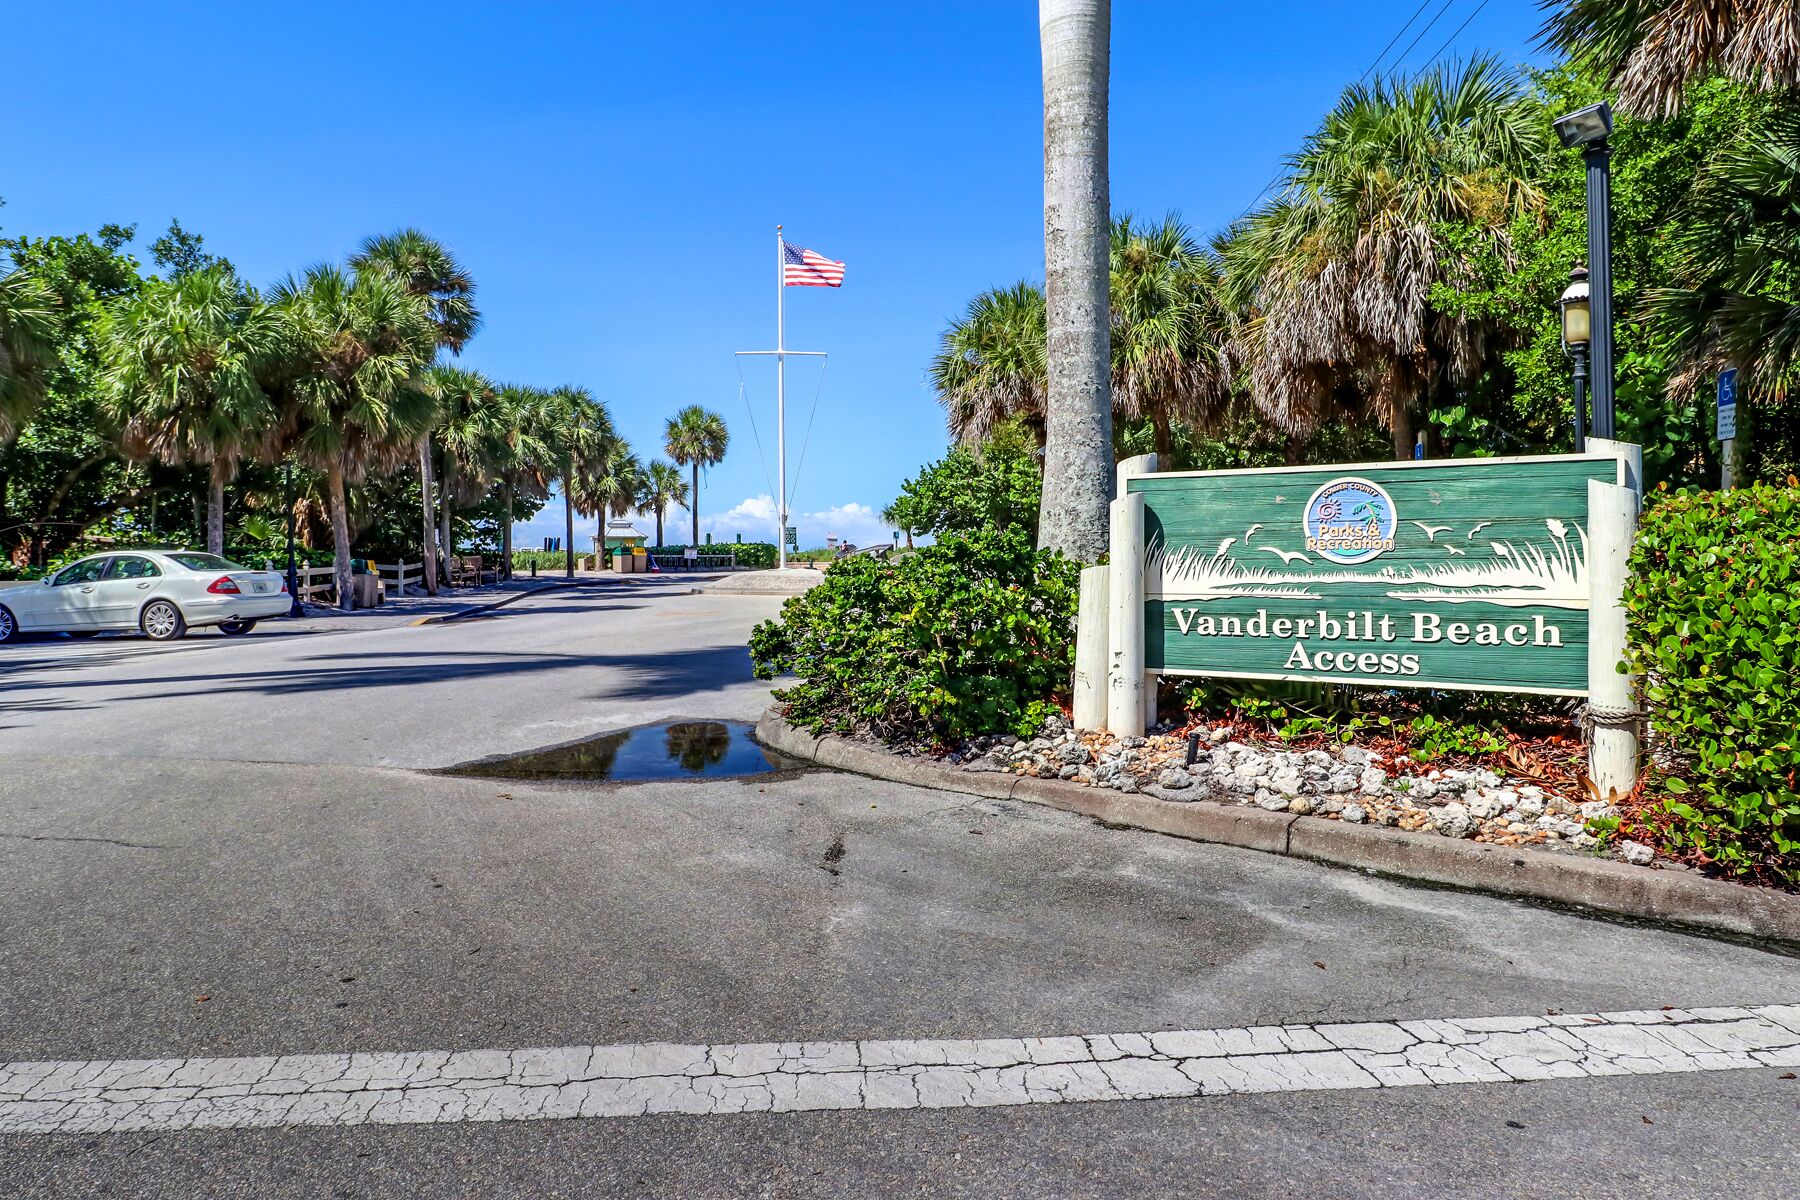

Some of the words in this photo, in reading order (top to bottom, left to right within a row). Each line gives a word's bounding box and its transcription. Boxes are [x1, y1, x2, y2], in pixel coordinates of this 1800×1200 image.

[1350, 483, 1379, 497] COUNTY
[1319, 524, 1363, 537] Parks
[1368, 524, 1381, 537] &
[1306, 537, 1393, 550] Recreation
[1171, 607, 1397, 642] Vanderbilt
[1410, 611, 1564, 648] Beach
[1283, 641, 1421, 675] Access
